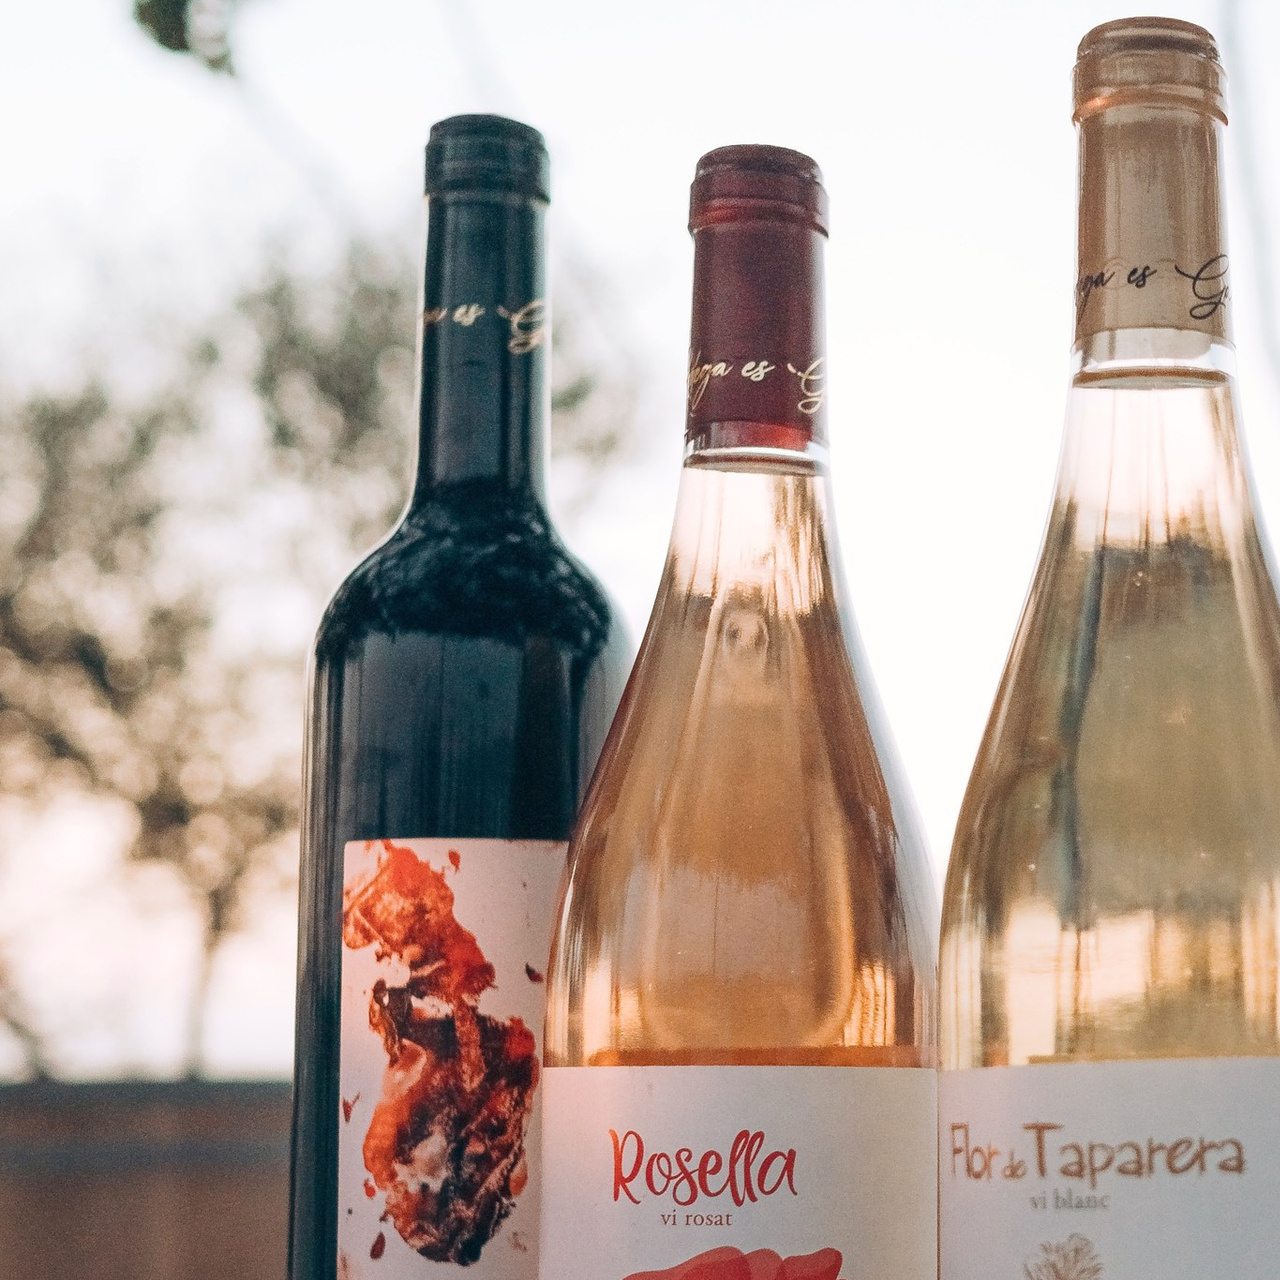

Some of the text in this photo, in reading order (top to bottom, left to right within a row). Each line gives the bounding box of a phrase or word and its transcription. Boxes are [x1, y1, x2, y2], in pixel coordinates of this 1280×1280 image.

[1127, 265, 1158, 288] es
[1174, 253, 1231, 320] G
[741, 360, 776, 382] es
[787, 357, 826, 414] G
[608, 1128, 798, 1208] Rosella
[951, 1121, 1246, 1189] Flor de Taparera
[660, 1209, 733, 1227] vi rosat
[1029, 1187, 1111, 1211] vi blanc
